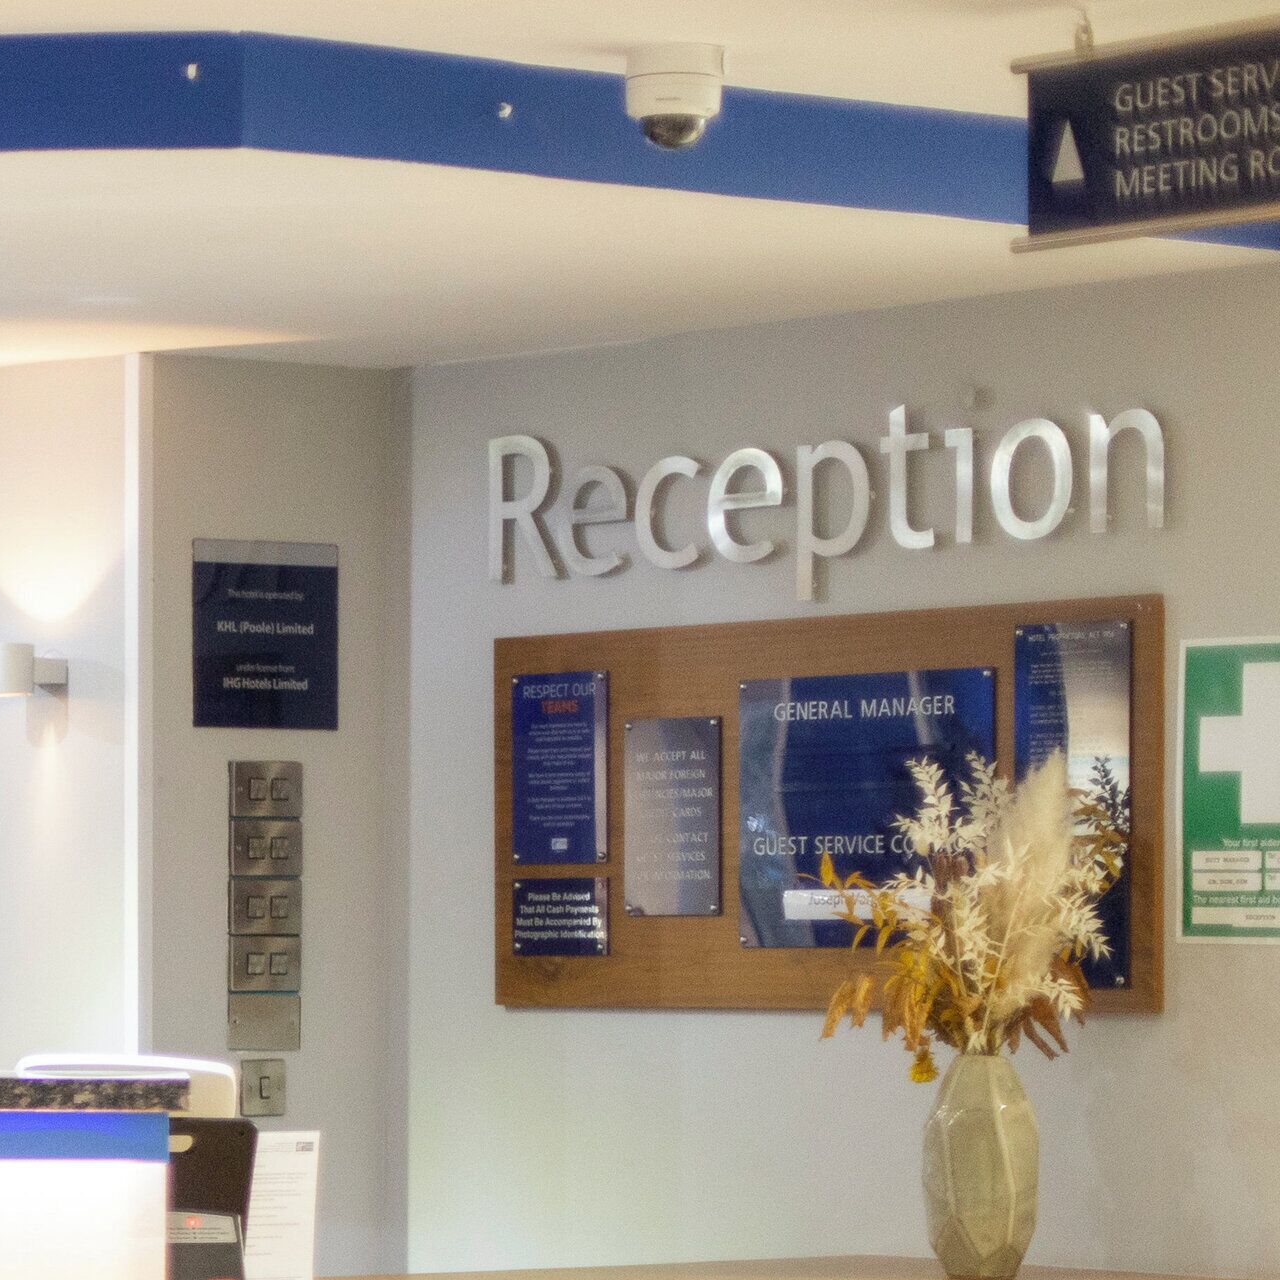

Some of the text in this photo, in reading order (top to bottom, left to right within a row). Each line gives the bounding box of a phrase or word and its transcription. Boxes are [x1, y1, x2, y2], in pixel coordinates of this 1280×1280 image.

[1114, 73, 1202, 112] GUEST
[1114, 153, 1239, 198] MEETING
[487, 404, 1165, 601] Reception
[216, 620, 238, 633] KHL
[276, 623, 315, 635] Limited
[223, 677, 308, 691] IHG Hotels Limited
[523, 682, 596, 699] RESPECT OUR
[773, 695, 955, 722] GENERAL MANAGER
[653, 751, 686, 762] ACCEPT
[689, 750, 706, 761] ALL
[753, 836, 808, 856] GUEST
[814, 835, 885, 854] SERVICE
[808, 891, 845, 908] Josep
